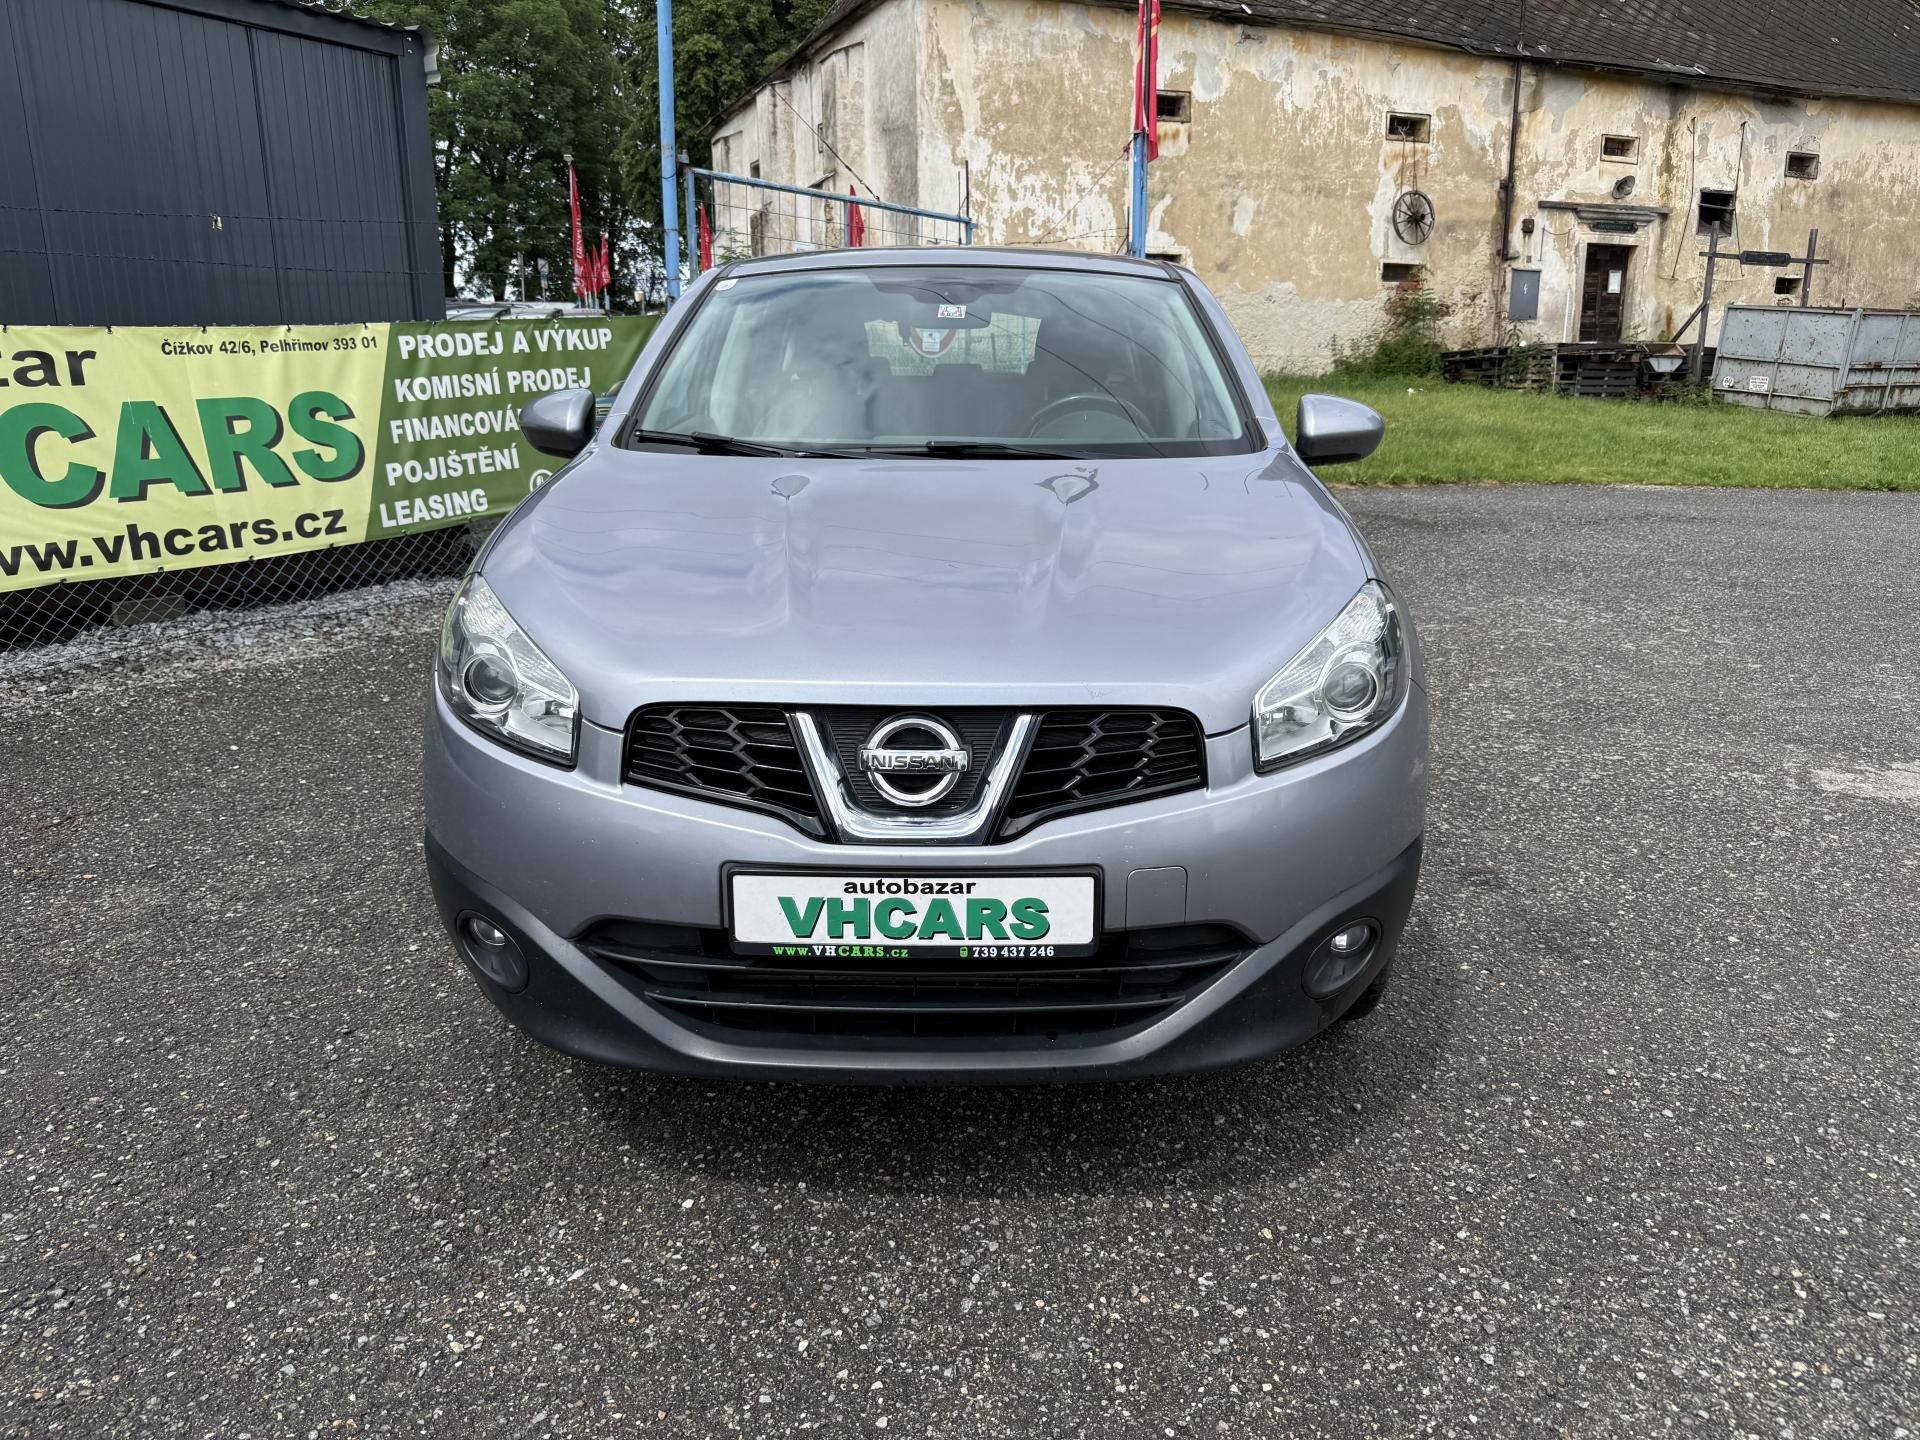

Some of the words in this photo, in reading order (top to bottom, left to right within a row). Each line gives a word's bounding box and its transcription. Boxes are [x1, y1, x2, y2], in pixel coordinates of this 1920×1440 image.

[161, 339, 213, 355] Čížkov
[219, 340, 256, 357] 42/6,
[260, 338, 329, 353] Pelhřimov
[333, 337, 357, 350] 393
[361, 336, 378, 349] 01
[398, 331, 504, 359] PRODEJ
[513, 331, 531, 353] A
[534, 323, 612, 352] VÝKUP
[0, 350, 97, 388] ar
[394, 366, 501, 403] KOMISNÍ
[507, 367, 591, 394] PRODEJ
[390, 404, 523, 444] FINANCOVÁ
[0, 391, 365, 510] CARS
[385, 442, 520, 486] POJIŠTĚNÍ
[379, 488, 489, 528] LEASING
[871, 755, 956, 770] NISSAN
[843, 878, 976, 895] autobazar
[777, 896, 1051, 940] VHCARS
[772, 945, 909, 958] www.VHCARS.cz
[972, 946, 998, 957] 739
[1000, 946, 1026, 957] 437
[1029, 946, 1055, 957] 246
